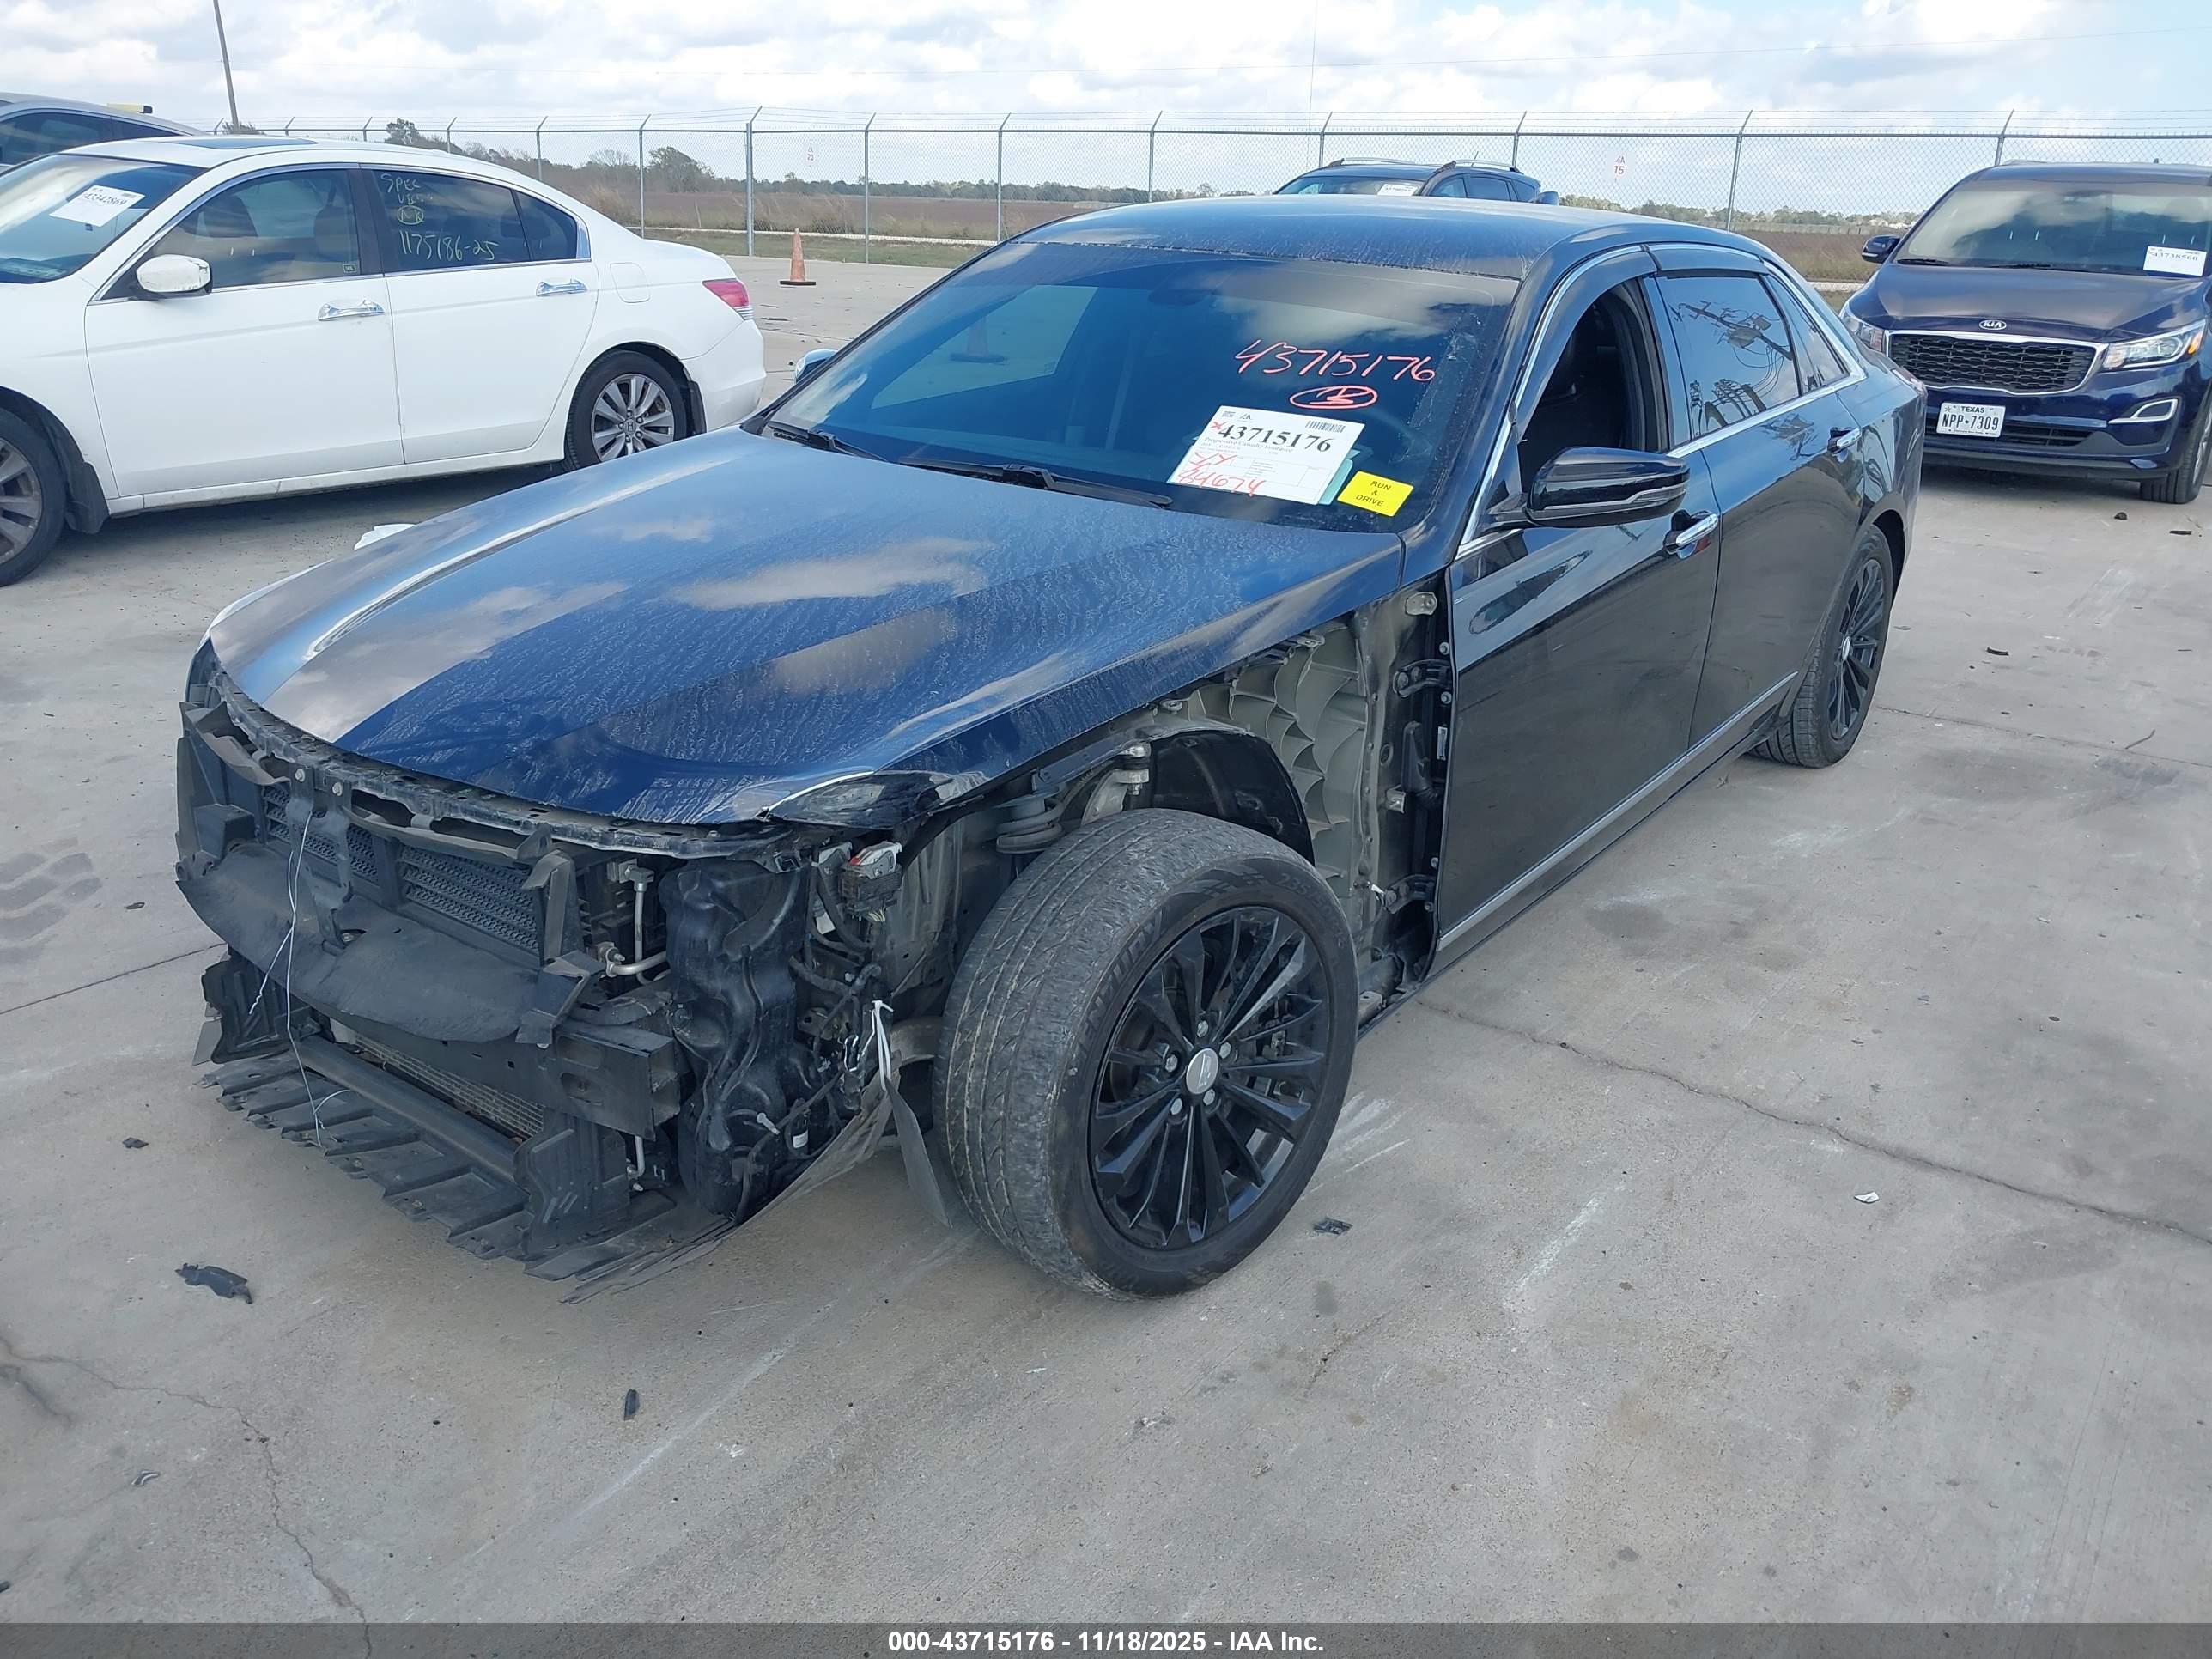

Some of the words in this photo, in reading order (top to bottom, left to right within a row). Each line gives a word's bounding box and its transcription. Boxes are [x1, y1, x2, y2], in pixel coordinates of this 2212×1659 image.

[1613, 165, 1626, 175] 15
[1234, 339, 1437, 382] 43715176
[1961, 405, 1985, 414] TEXAS
[1218, 424, 1336, 453] 43715176
[1370, 480, 1392, 491] RUN
[1355, 494, 1384, 507] DRIVE
